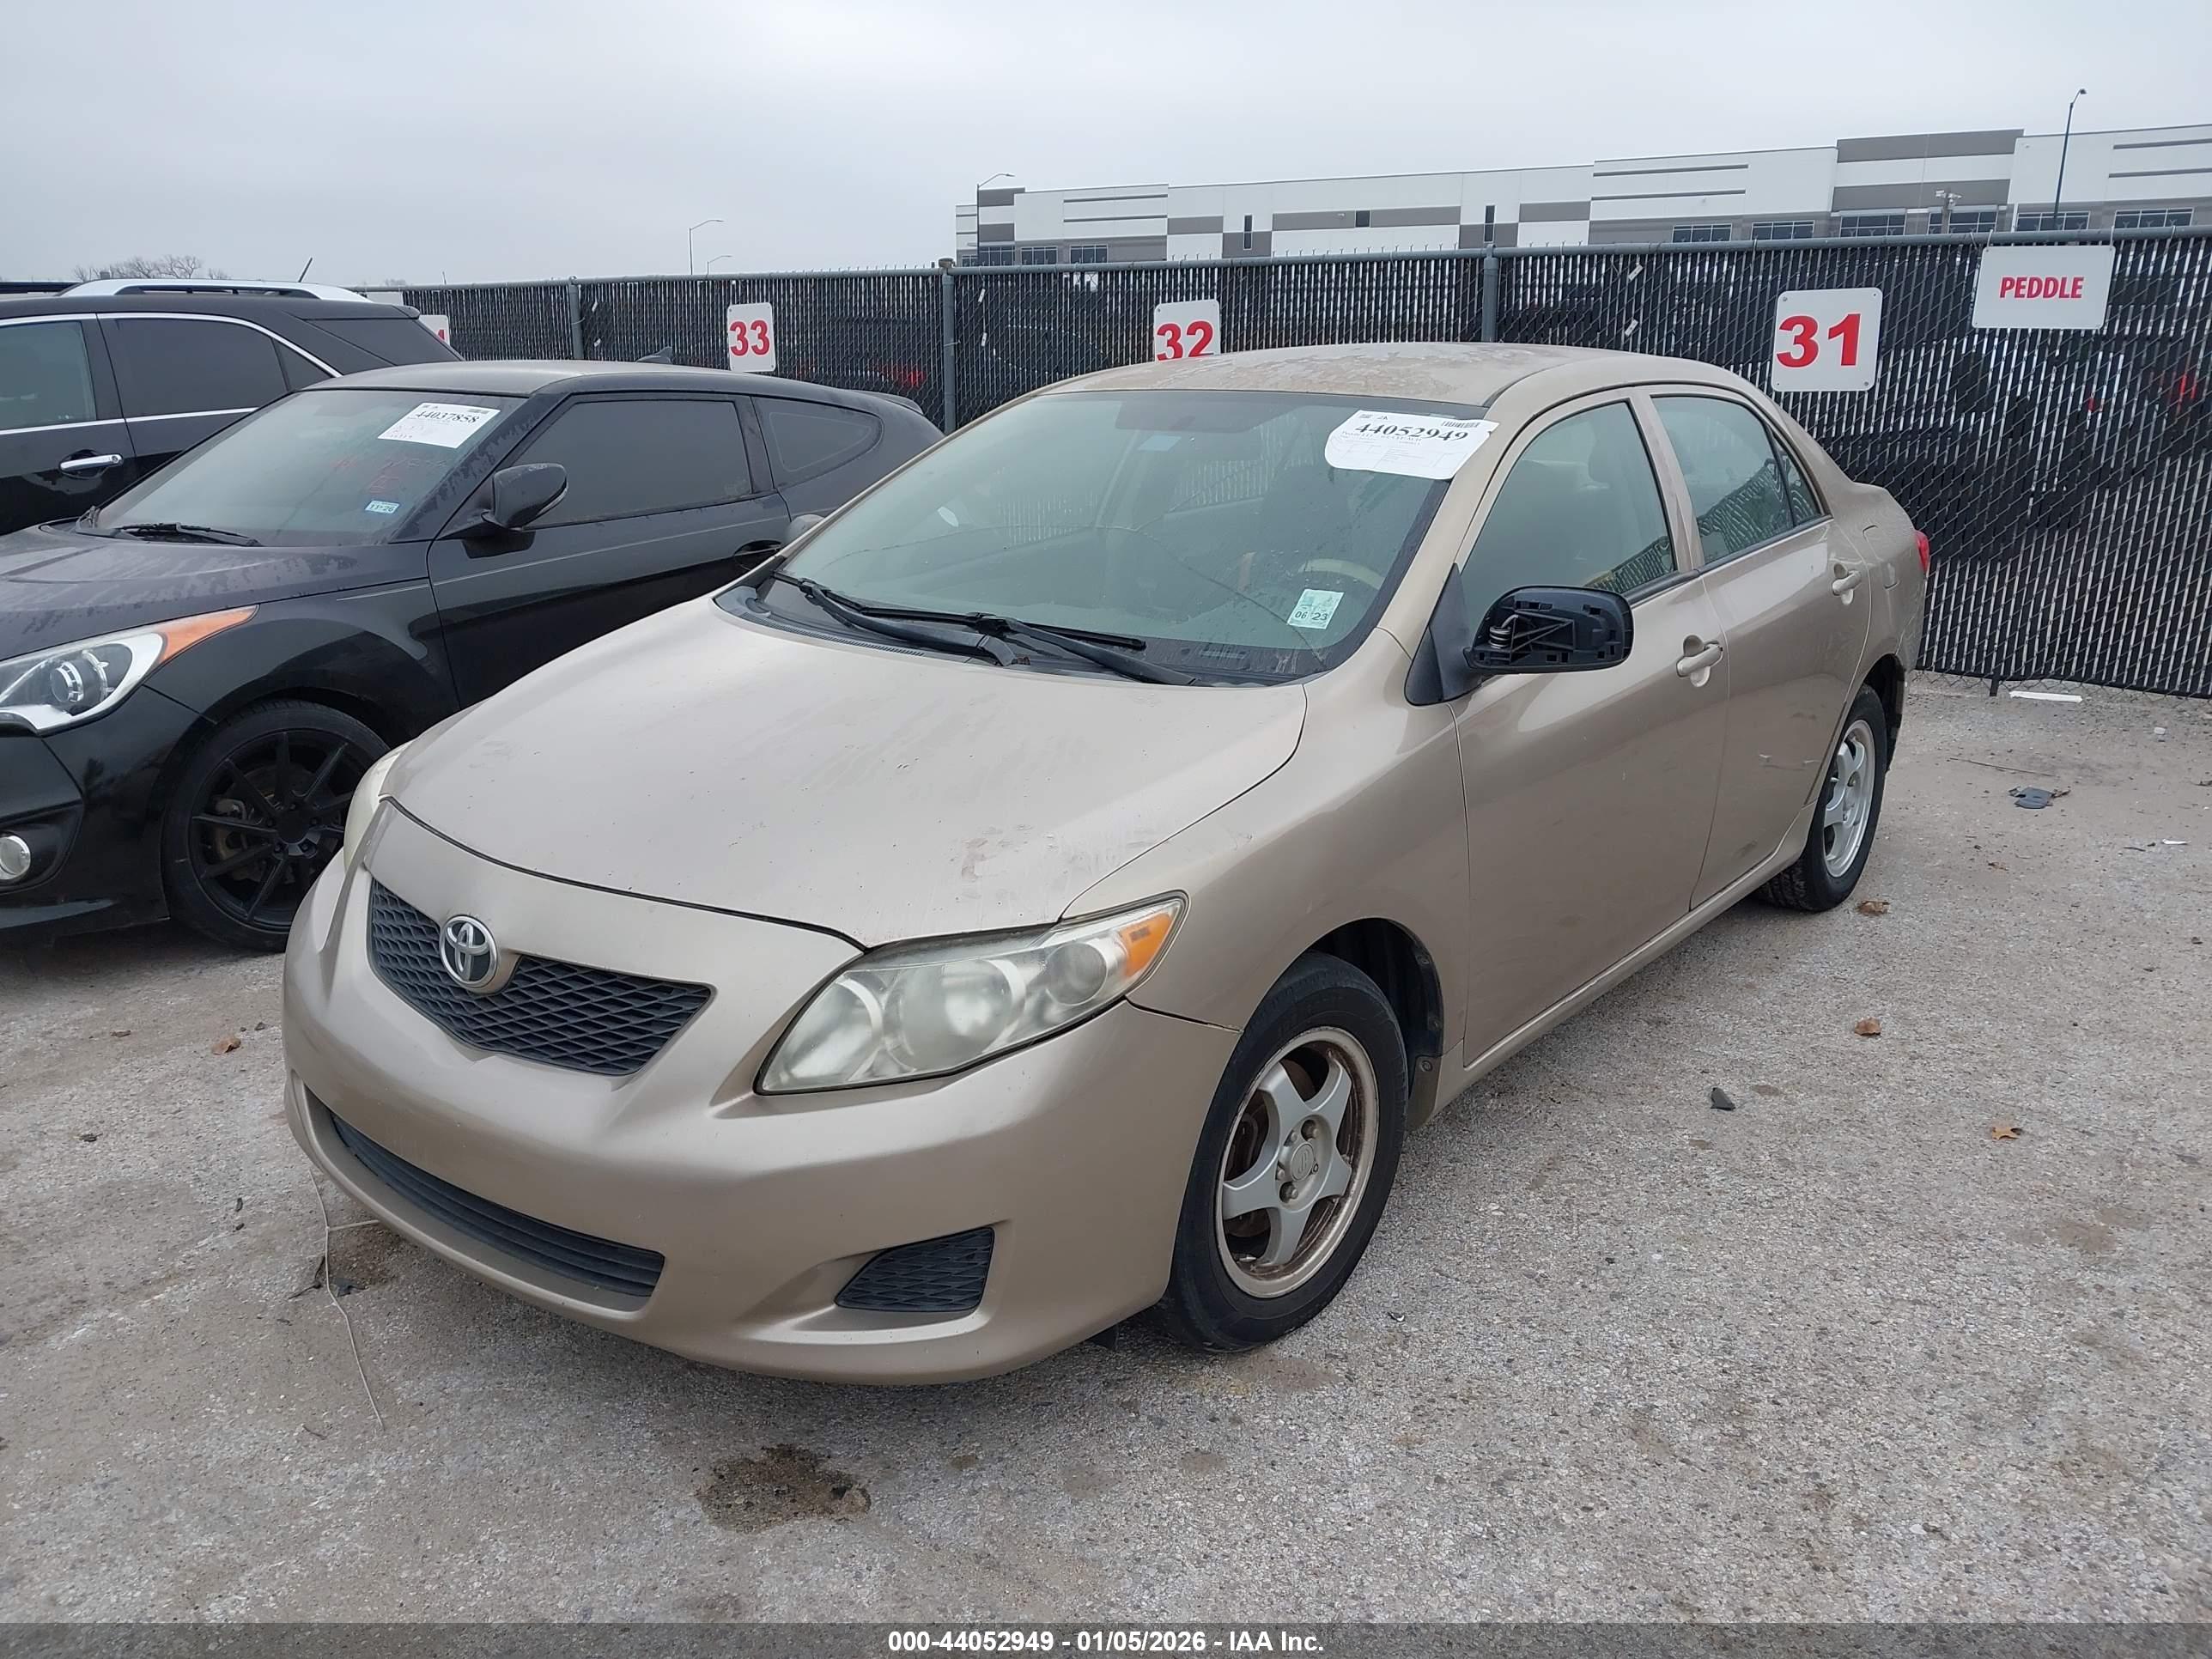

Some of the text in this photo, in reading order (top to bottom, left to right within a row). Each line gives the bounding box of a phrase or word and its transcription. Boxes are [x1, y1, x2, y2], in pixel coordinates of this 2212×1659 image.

[1999, 276, 2085, 299] PEDDLE
[728, 320, 771, 356] 33
[1156, 320, 1215, 361] 32
[1776, 313, 1862, 368] 31
[416, 410, 480, 423] 44037858
[1354, 422, 1468, 441] 44052949
[1295, 611, 1328, 621] 06 23
